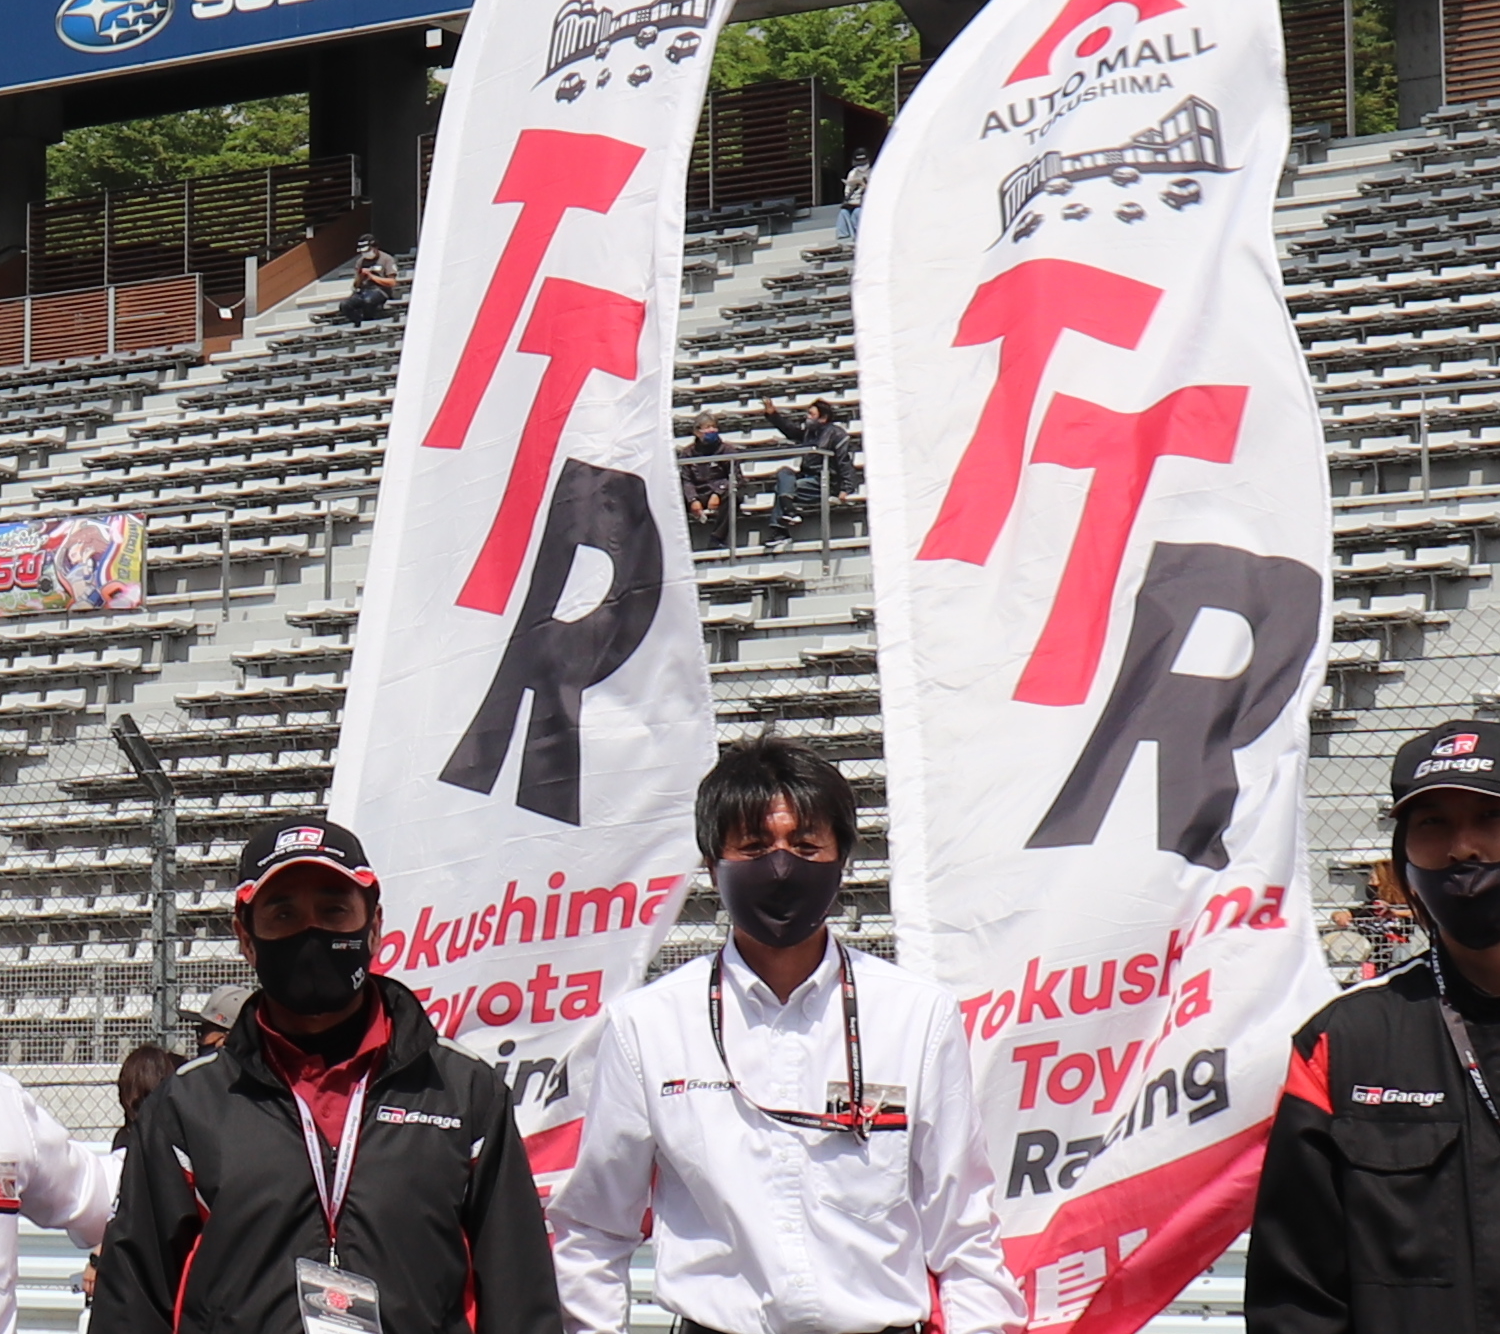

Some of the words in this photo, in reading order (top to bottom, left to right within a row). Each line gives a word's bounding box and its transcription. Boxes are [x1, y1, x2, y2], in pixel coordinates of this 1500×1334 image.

[979, 71, 1085, 139] AUTO
[1095, 28, 1216, 81] MALL
[1024, 74, 1173, 146] TOKUSHIMA
[1433, 735, 1478, 756] GR
[1413, 756, 1493, 779] Garage
[276, 830, 323, 847] GR
[370, 871, 687, 975] okushima
[1354, 1090, 1383, 1104] GR
[1383, 1088, 1444, 1107] Garage
[405, 1111, 461, 1130] Garage
